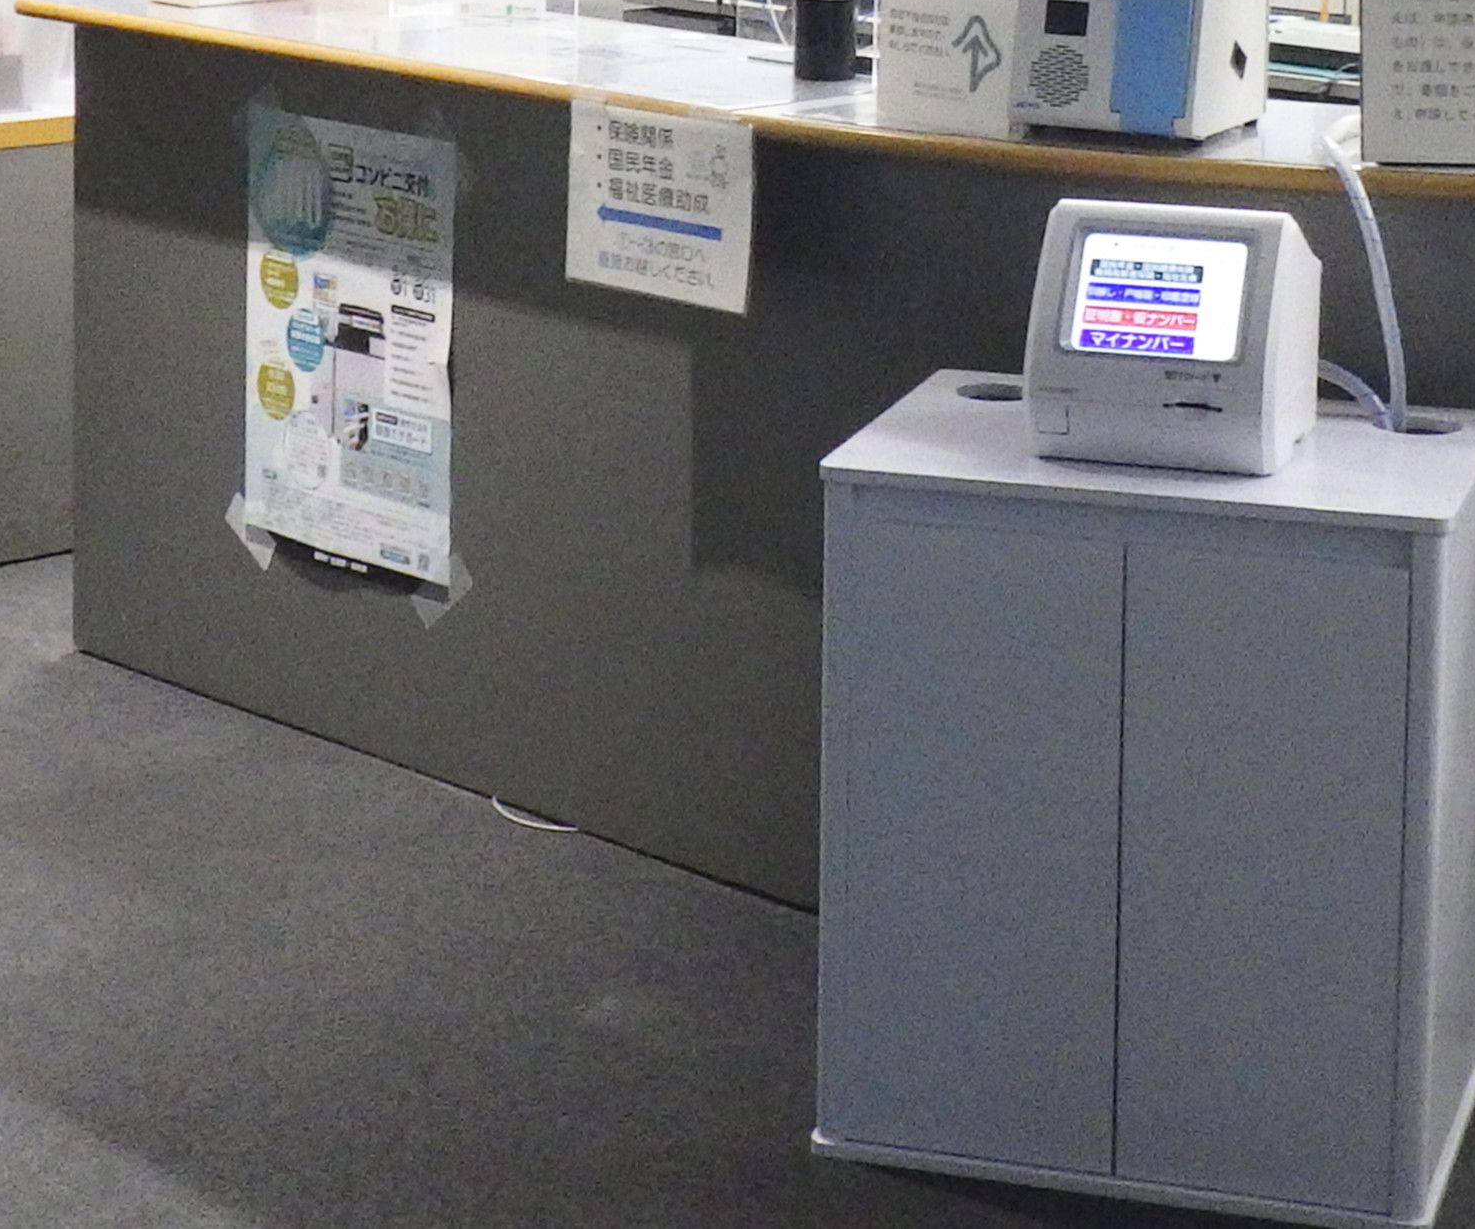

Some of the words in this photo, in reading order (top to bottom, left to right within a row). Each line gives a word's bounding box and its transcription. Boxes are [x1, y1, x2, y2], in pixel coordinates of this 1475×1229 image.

[1089, 331, 1185, 350] マイナンバー
